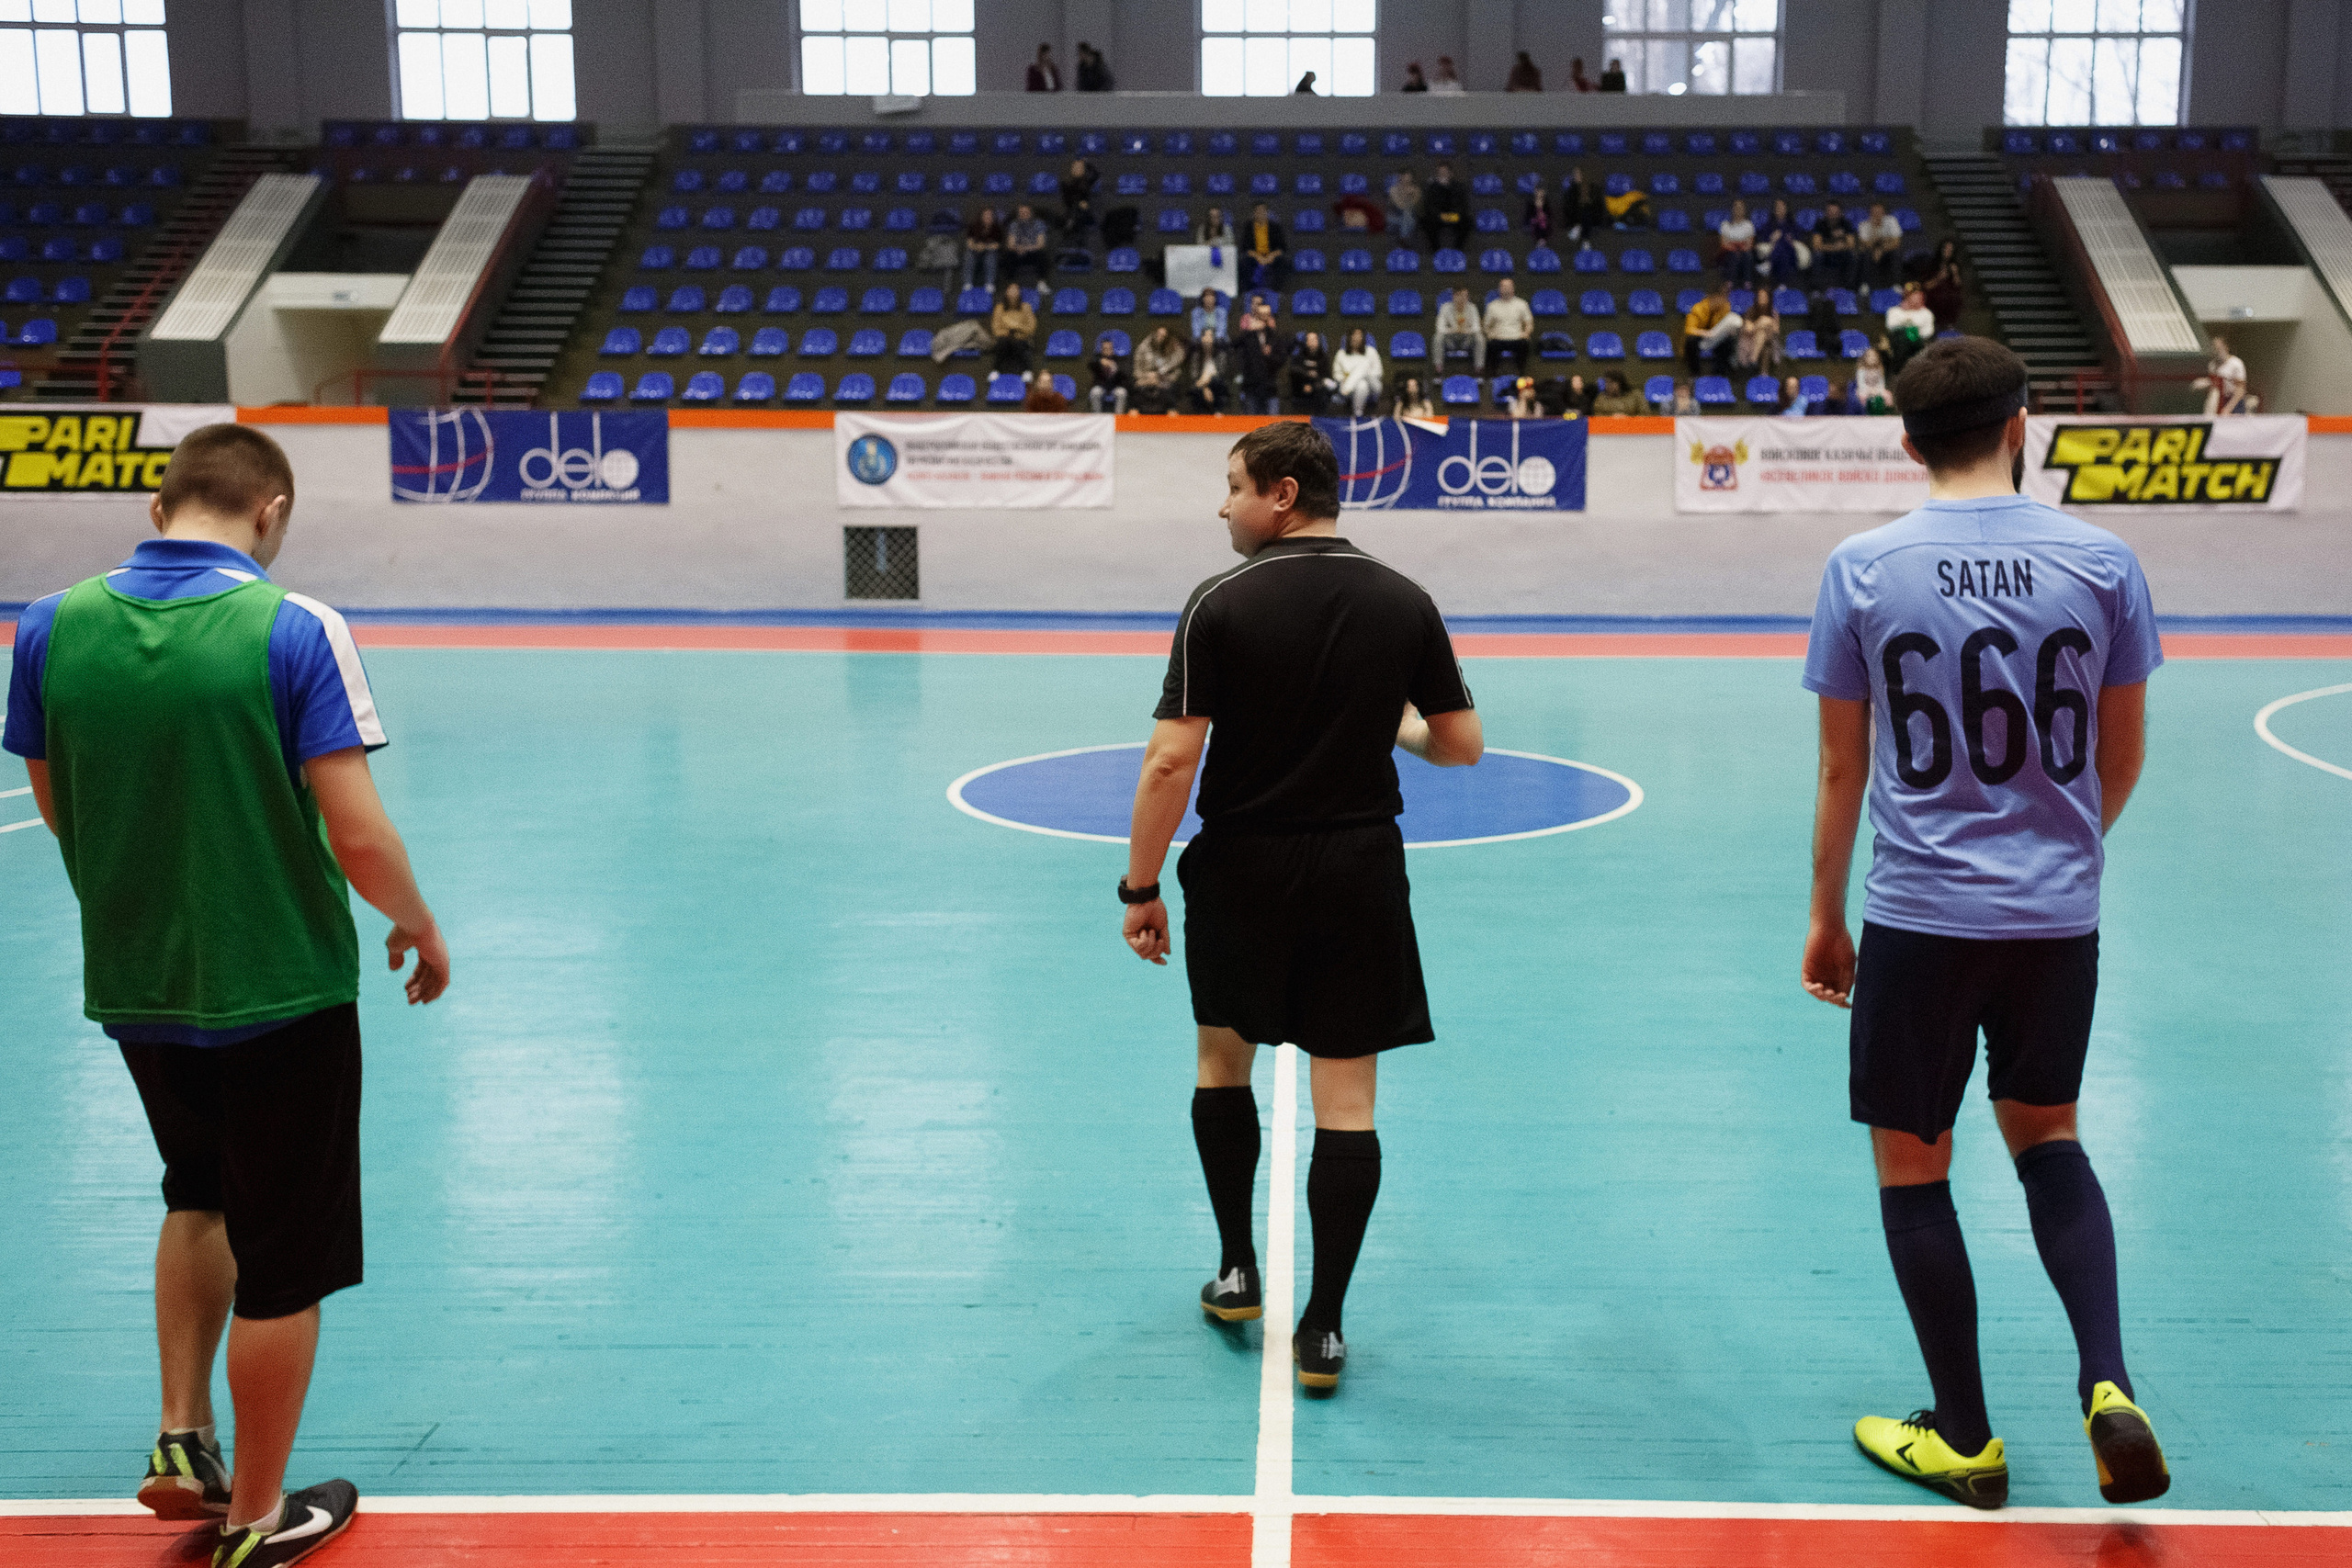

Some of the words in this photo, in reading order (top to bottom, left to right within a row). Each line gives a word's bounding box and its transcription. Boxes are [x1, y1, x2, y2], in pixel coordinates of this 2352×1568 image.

[0, 415, 135, 452] PARI
[518, 410, 640, 491] delo
[2052, 427, 2205, 464] PARI
[5, 452, 173, 488] MATC
[1436, 419, 1557, 496] delo
[2069, 462, 2273, 500] MATCH
[1937, 558, 2034, 598] SATAN
[1883, 626, 2093, 790] 666
